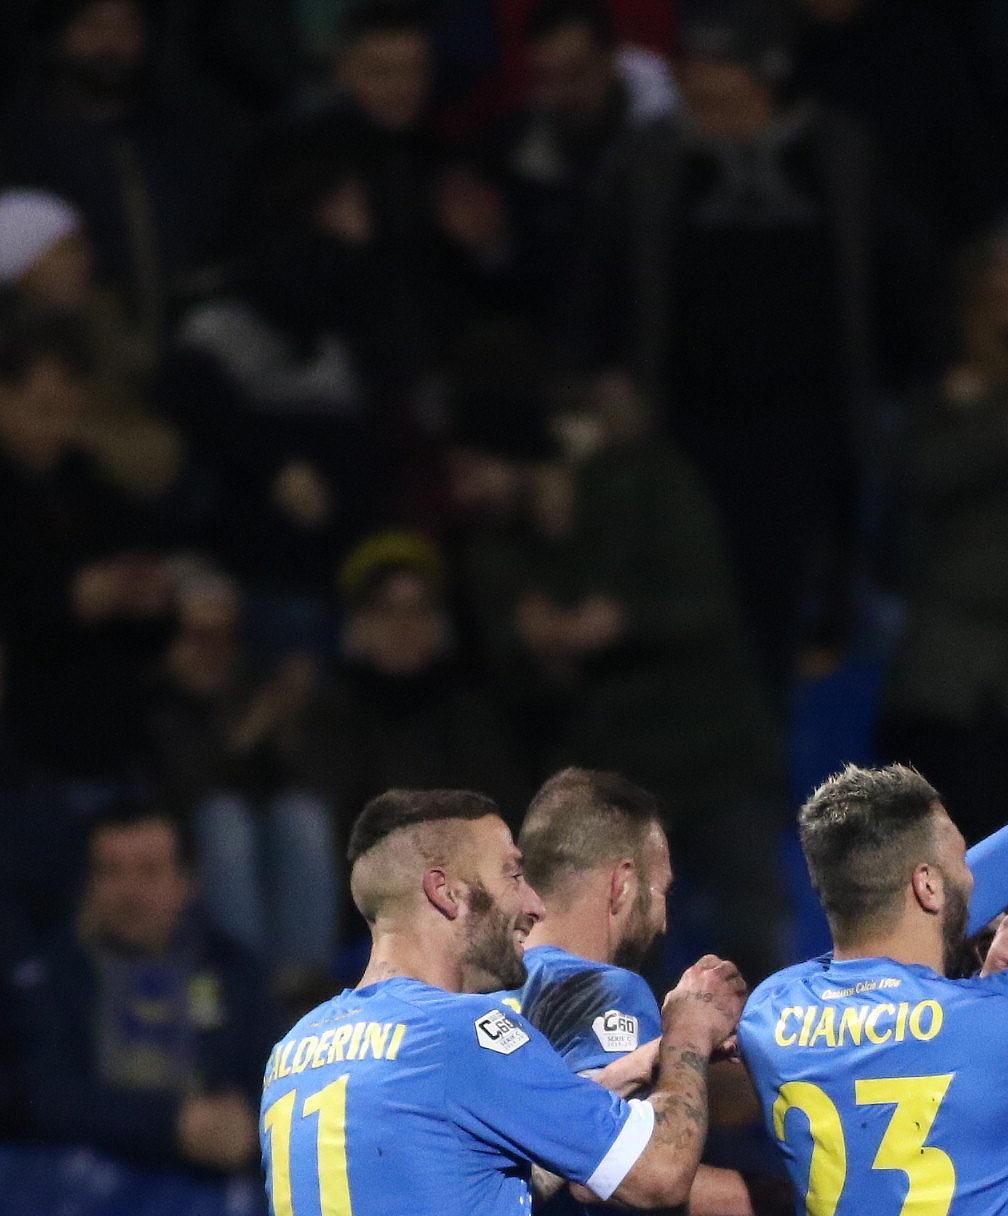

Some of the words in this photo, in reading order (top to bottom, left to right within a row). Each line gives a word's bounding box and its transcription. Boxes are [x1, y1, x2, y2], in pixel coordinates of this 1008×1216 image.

[604, 1012, 635, 1034] C60
[774, 1000, 945, 1047] CIANCIO
[263, 1022, 407, 1090] ALDERINI
